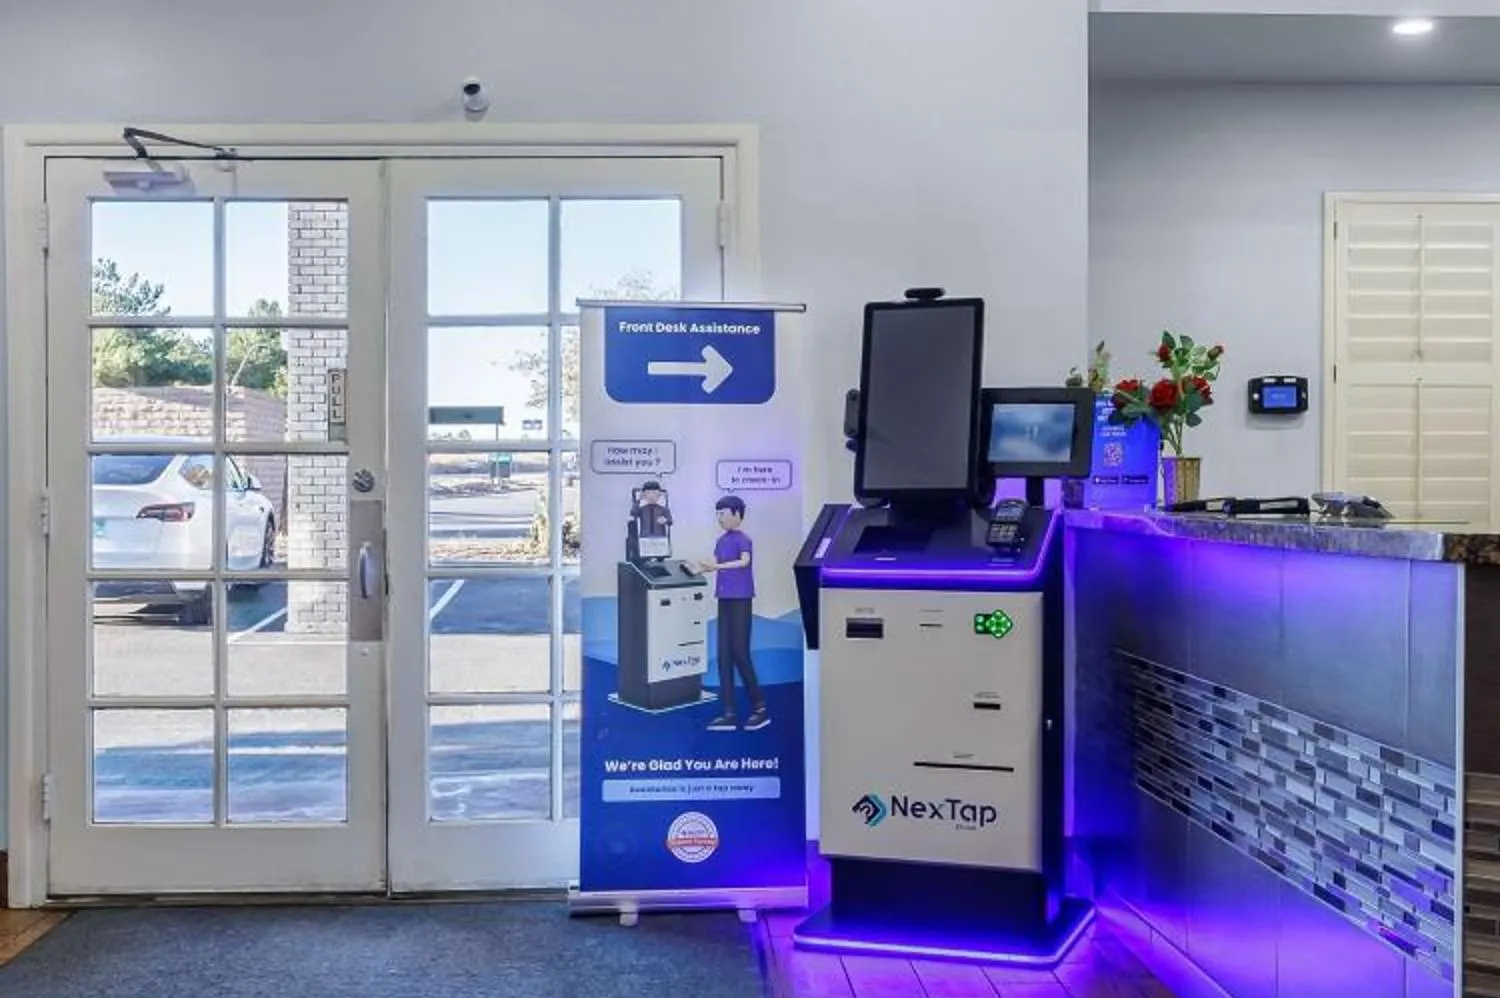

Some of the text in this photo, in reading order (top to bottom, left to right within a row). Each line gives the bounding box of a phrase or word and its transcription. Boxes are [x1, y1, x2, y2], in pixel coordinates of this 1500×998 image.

[618, 320, 761, 335] Front Desk Assistance
[331, 372, 343, 419] PULL
[604, 756, 779, 773] We're Glad You Are Here!
[890, 794, 997, 828] NexTap
